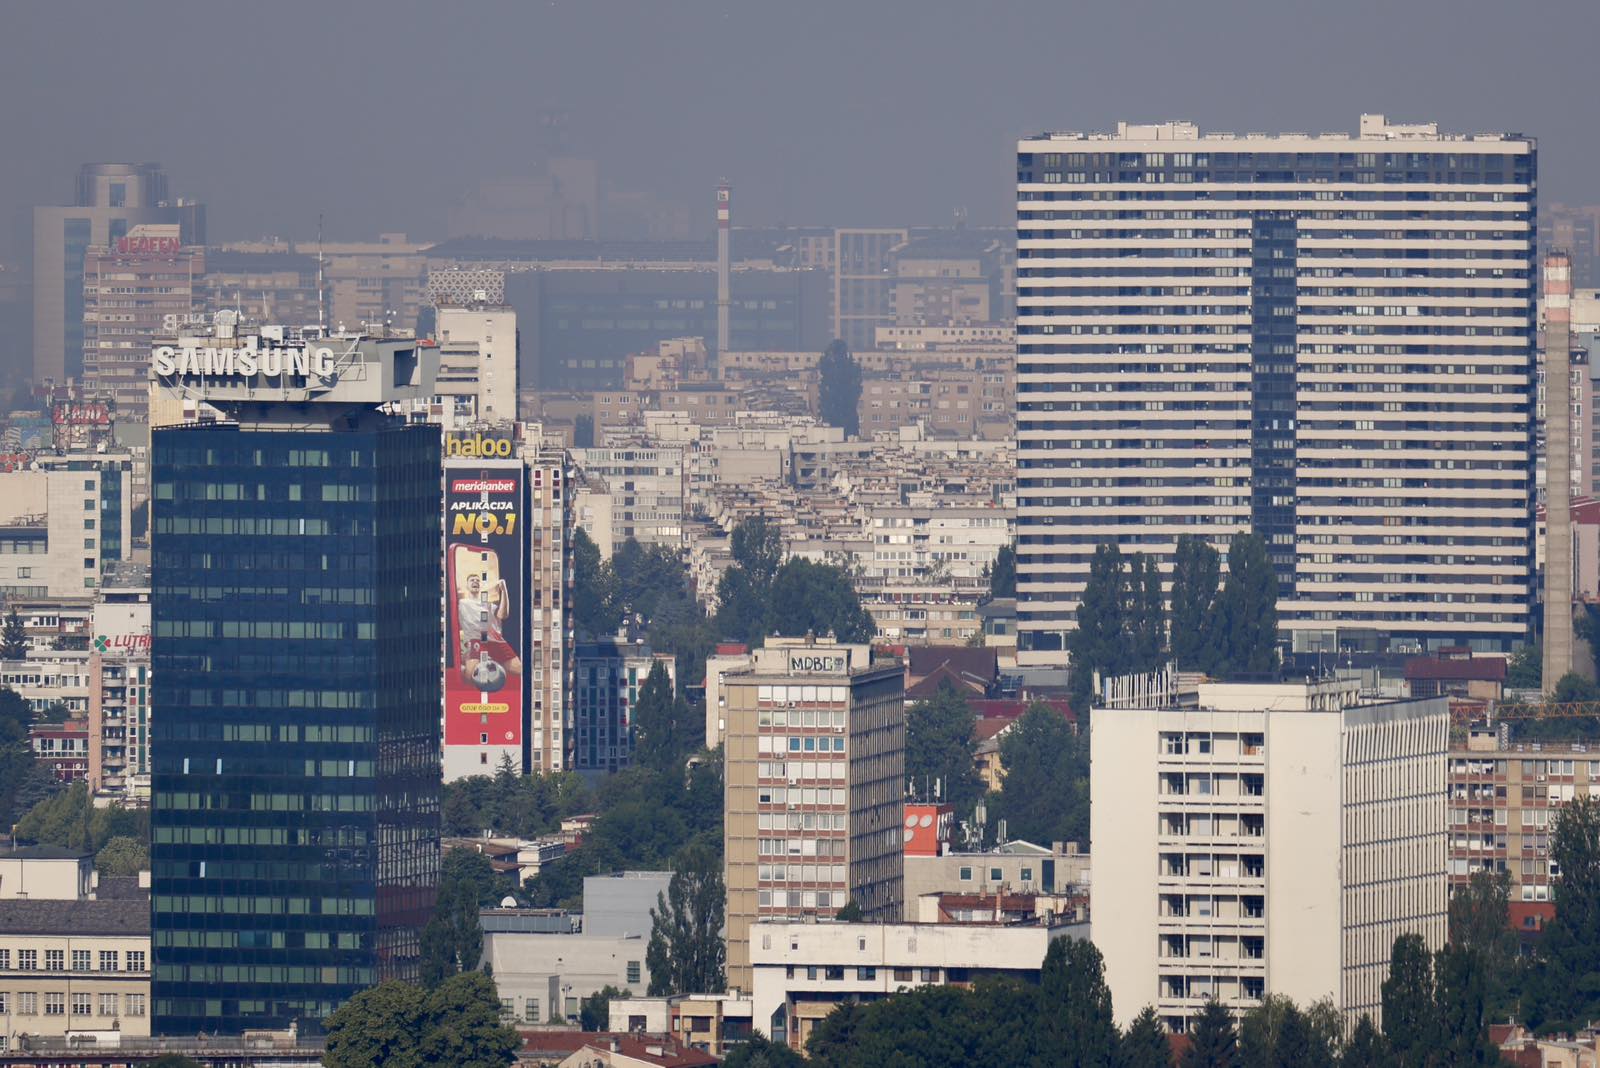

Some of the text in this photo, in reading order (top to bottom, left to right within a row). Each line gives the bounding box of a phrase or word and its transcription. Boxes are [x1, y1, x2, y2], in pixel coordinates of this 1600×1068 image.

[155, 346, 334, 377] SAMSUNG
[446, 433, 512, 457] haloo
[455, 481, 514, 491] meridianbet
[450, 501, 514, 511] APLIKACIJA
[452, 512, 517, 535] NO.1
